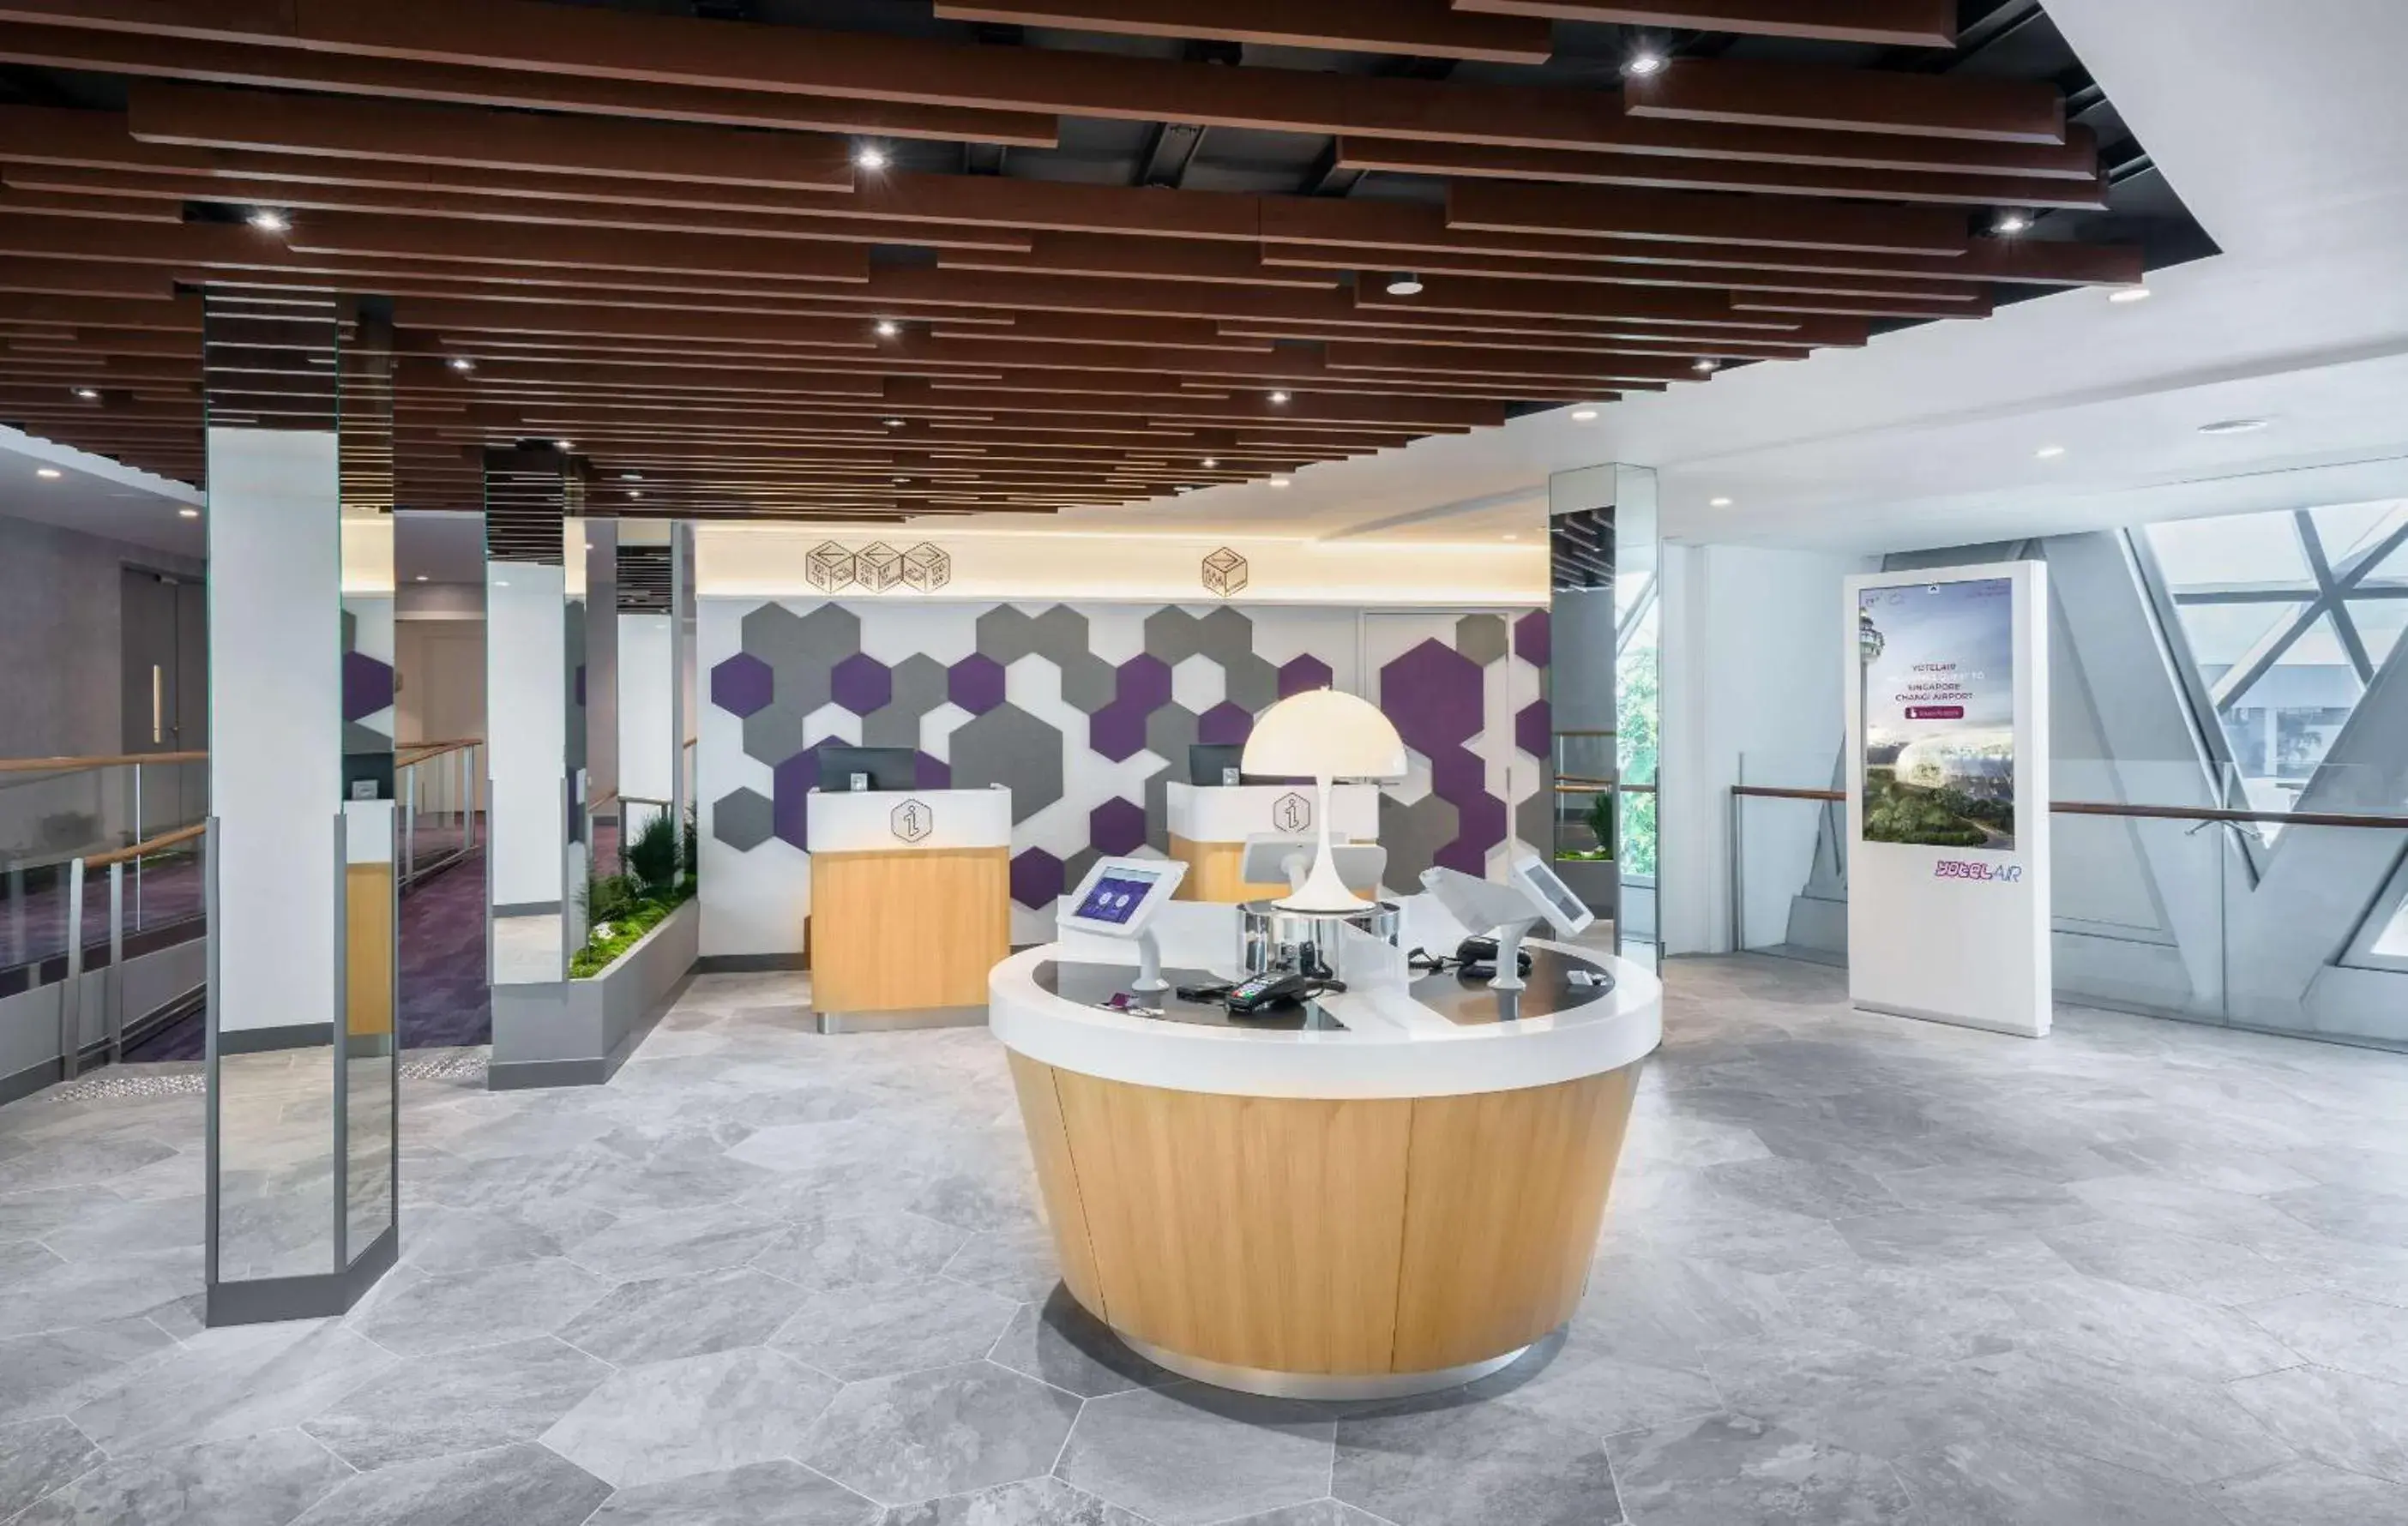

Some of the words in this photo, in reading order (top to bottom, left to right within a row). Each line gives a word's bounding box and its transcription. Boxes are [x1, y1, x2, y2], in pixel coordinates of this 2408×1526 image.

[1907, 682, 1962, 691] SINGAPORE
[1894, 694, 1931, 702] CHANGI
[1932, 692, 1975, 701] AIRPORT
